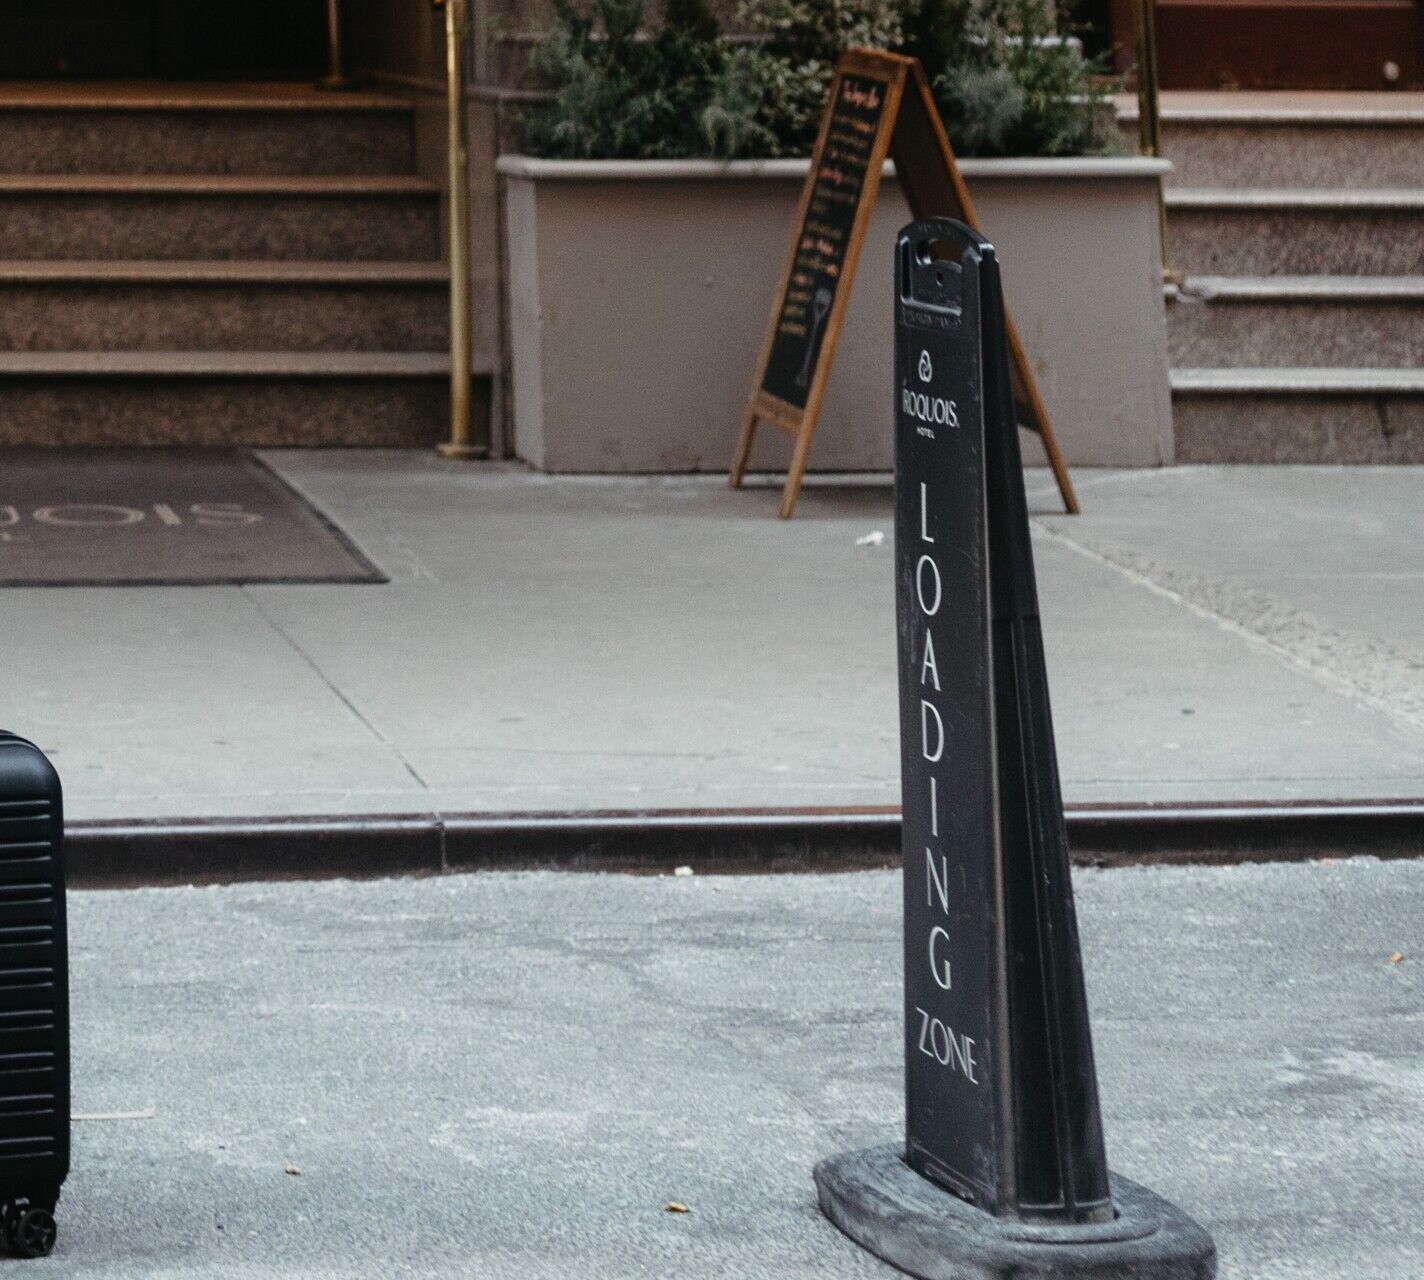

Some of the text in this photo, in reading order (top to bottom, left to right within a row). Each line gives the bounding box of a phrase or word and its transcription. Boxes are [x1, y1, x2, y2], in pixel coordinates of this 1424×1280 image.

[902, 388, 958, 428] ROQUOIS
[915, 482, 951, 991] LOADING
[916, 1006, 979, 1085] ZONE
